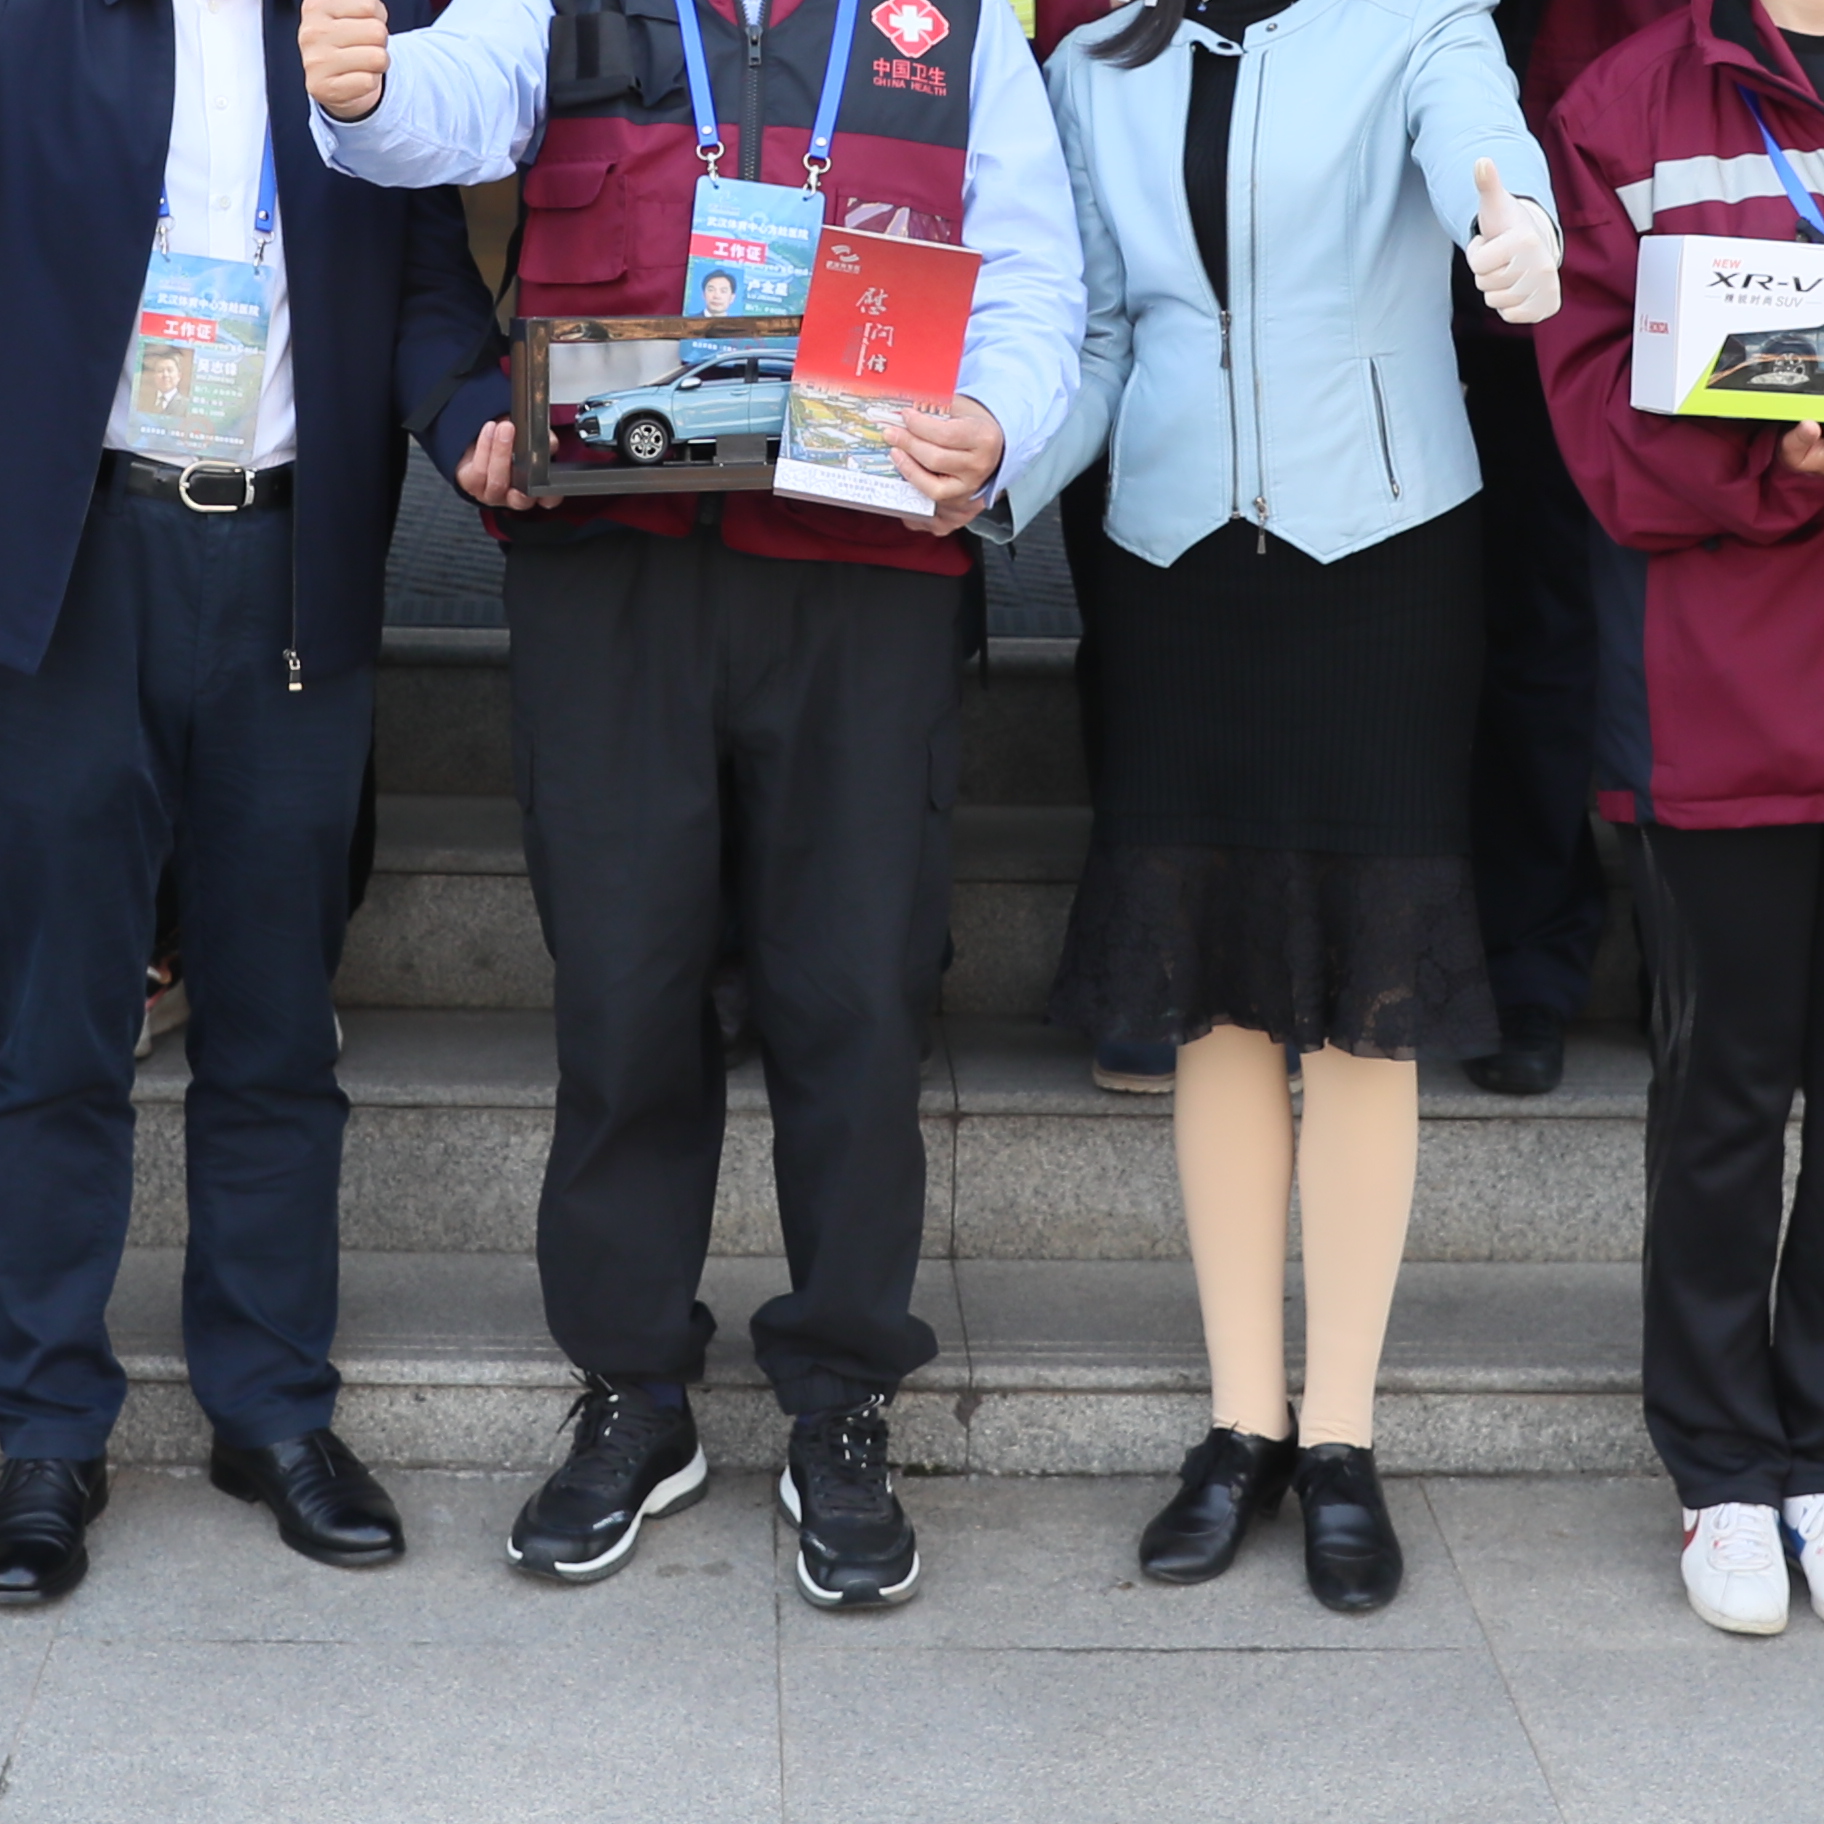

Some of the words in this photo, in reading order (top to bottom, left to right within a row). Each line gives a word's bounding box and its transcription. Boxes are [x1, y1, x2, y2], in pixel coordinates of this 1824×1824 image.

[873, 57, 947, 87] 中国卫生
[873, 76, 907, 89] CHINA
[910, 82, 947, 97] HEALTH
[713, 241, 762, 262] 工作证
[1712, 258, 1742, 269] NEW
[1705, 271, 1824, 293] XR-V
[163, 319, 212, 341] 工作证
[855, 286, 894, 373] 慰问信
